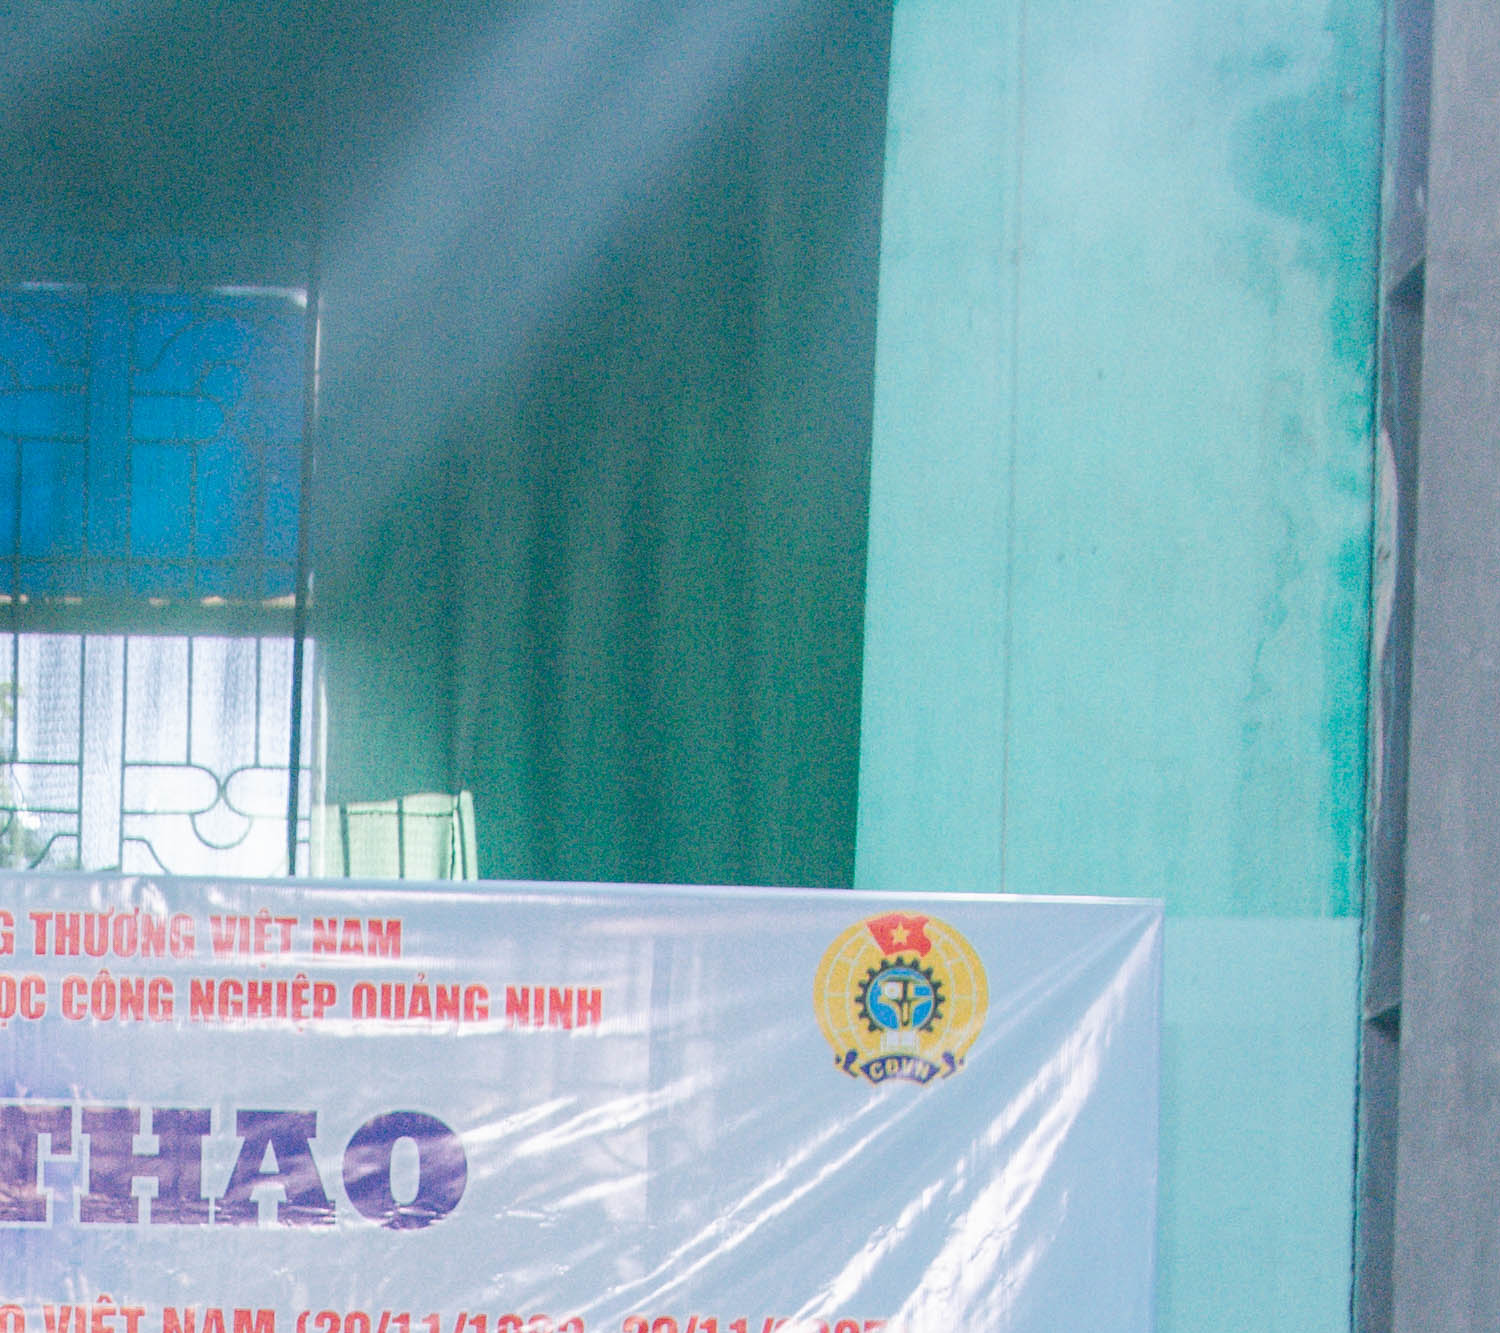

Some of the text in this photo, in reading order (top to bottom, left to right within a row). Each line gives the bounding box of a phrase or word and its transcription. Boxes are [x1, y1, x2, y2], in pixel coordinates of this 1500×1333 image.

[29, 907, 195, 959] THƯƠNG
[209, 908, 299, 968] VIỆT
[312, 918, 402, 959] NAM
[61, 969, 174, 1022] CÔNG
[190, 974, 337, 1032] NGHIỆP
[345, 972, 490, 1024] QUẢNG
[505, 985, 603, 1030] NINH
